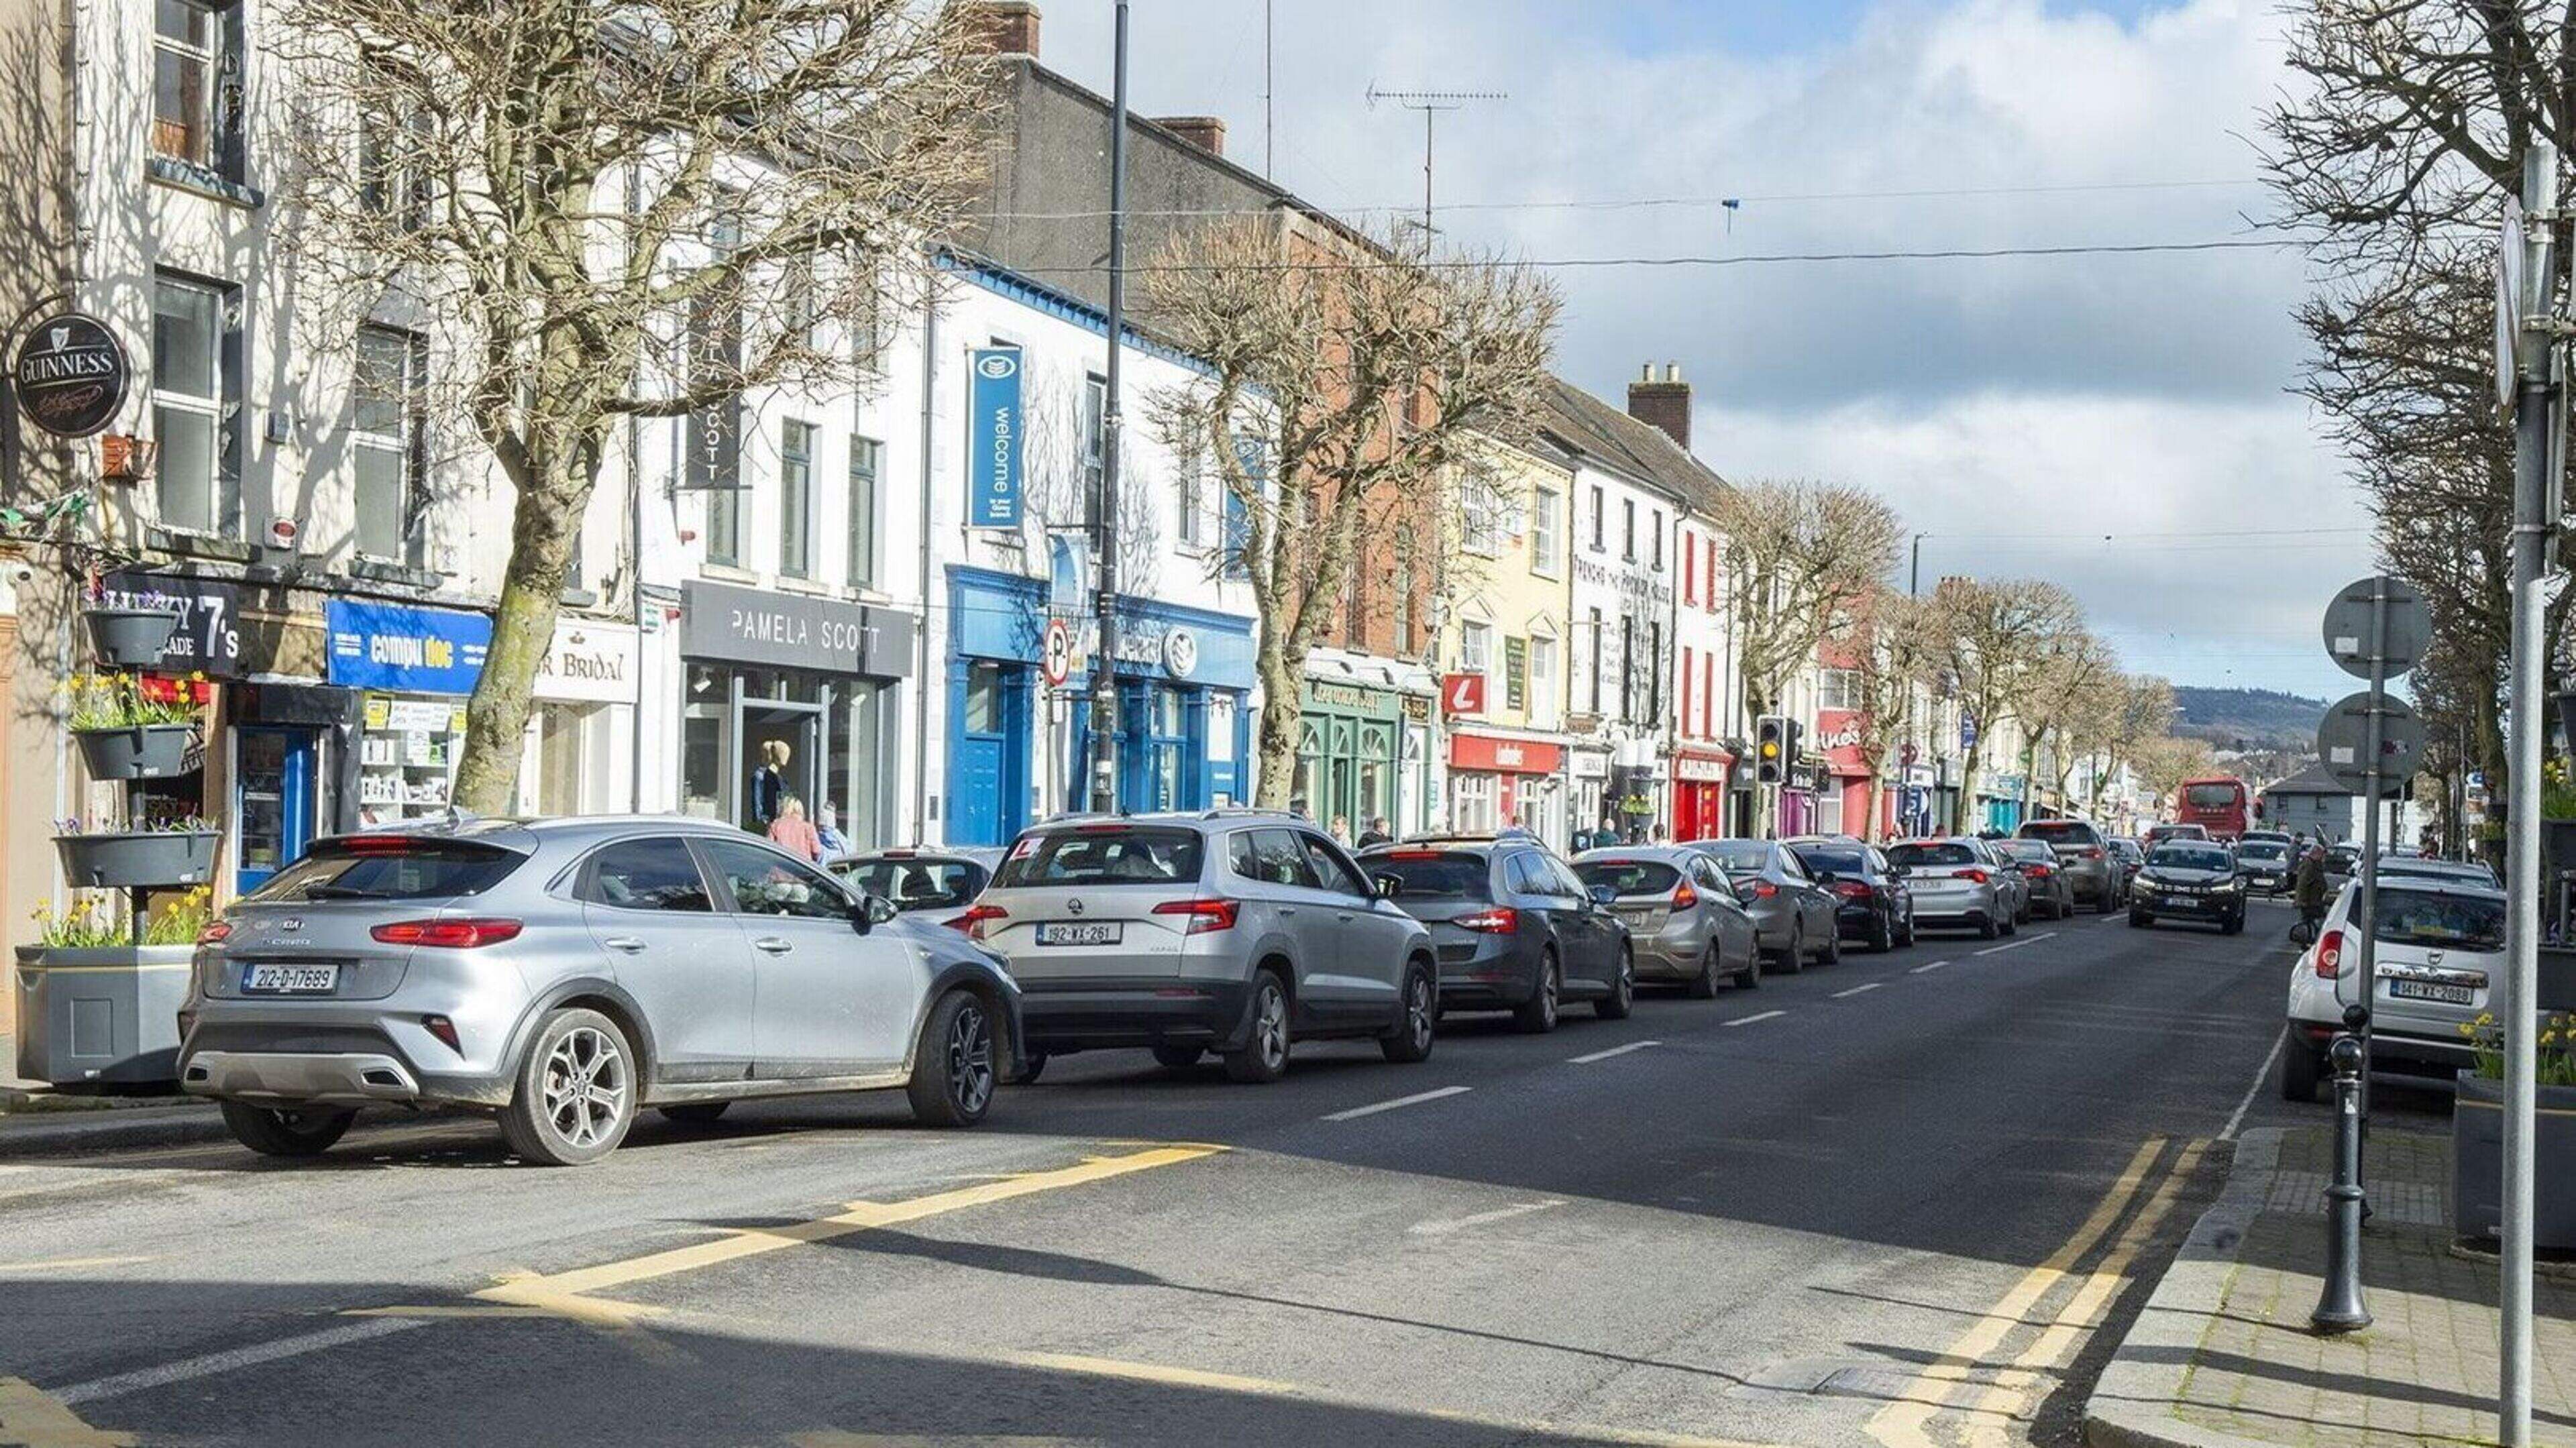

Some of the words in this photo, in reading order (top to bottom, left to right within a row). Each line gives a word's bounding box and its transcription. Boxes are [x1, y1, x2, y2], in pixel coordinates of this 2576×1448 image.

[21, 352, 113, 384] GUINNESS
[994, 407, 1013, 492] welcome
[733, 610, 808, 646] PAMELA
[162, 636, 195, 656] ADE
[370, 634, 423, 670] compu
[425, 636, 454, 668] doc
[1053, 632, 1064, 673] P
[1014, 840, 1030, 857] L
[1049, 927, 1110, 940] 192-WX-261
